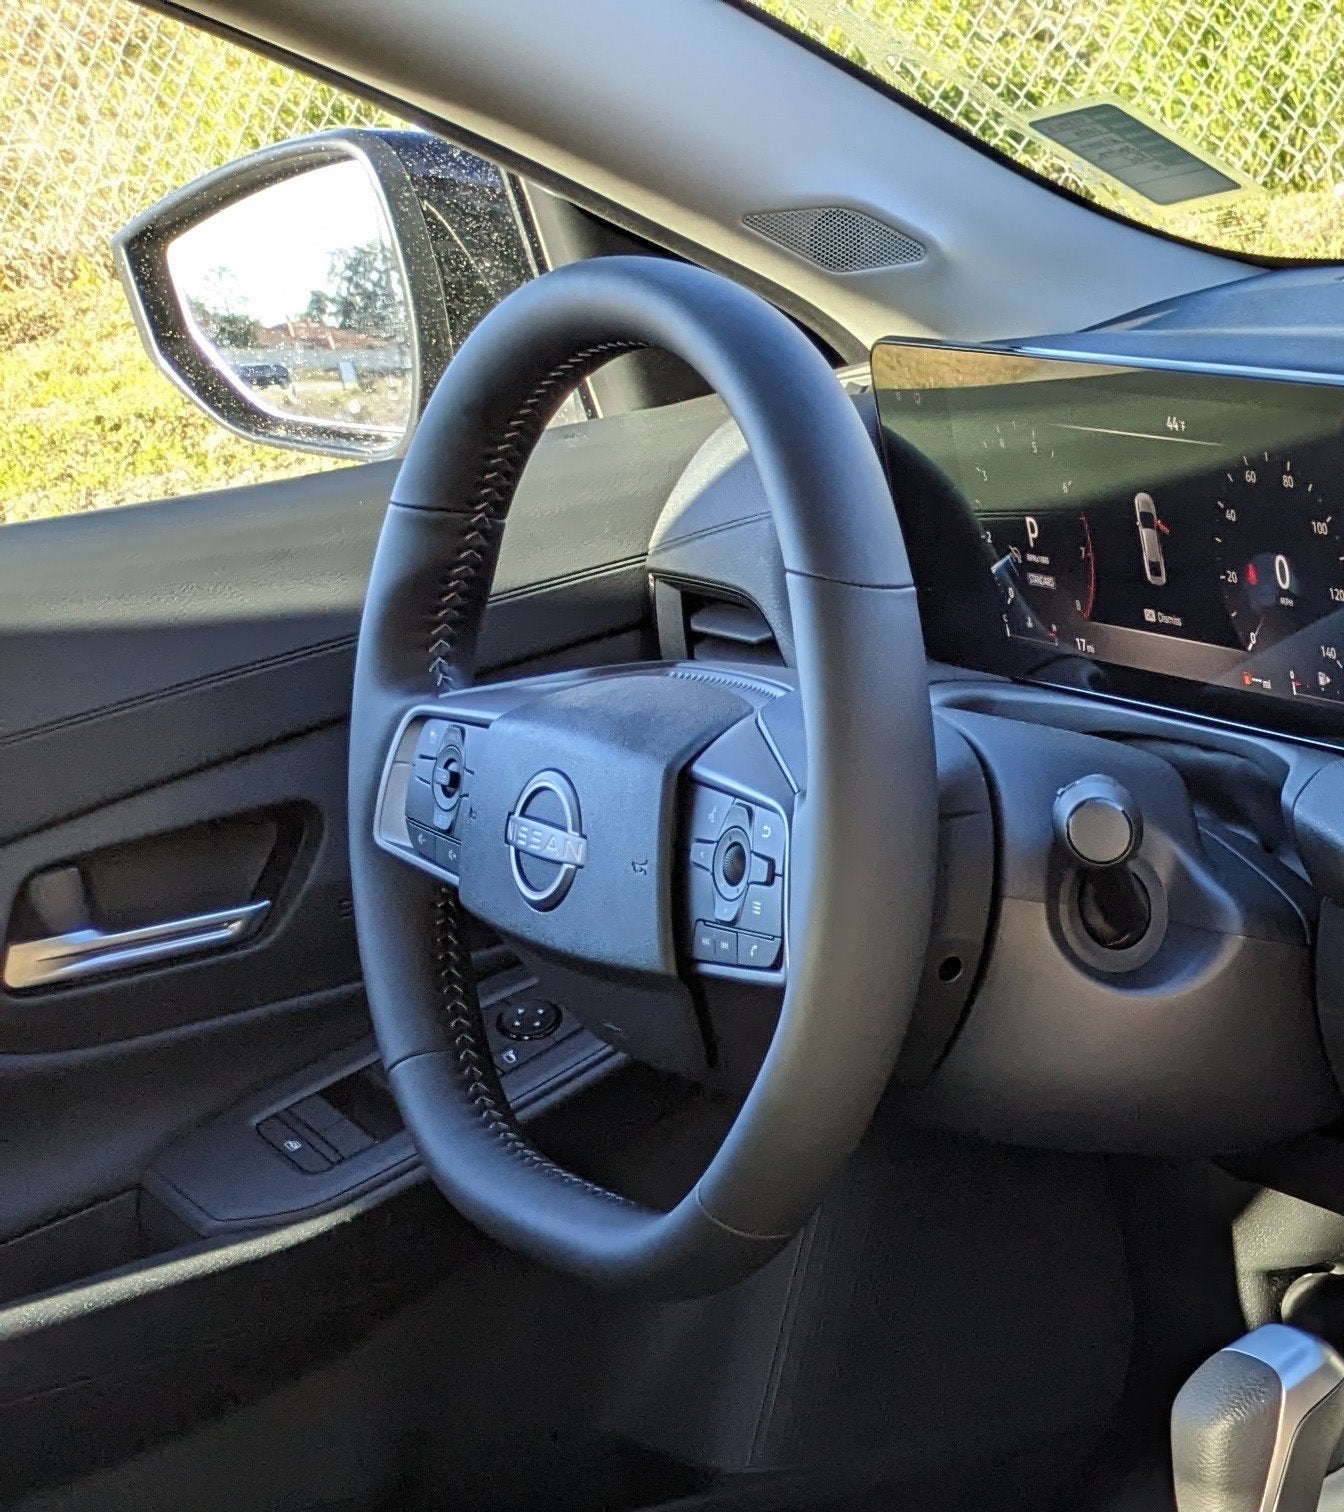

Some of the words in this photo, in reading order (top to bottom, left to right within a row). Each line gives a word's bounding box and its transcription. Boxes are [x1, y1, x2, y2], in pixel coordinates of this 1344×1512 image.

[1245, 470, 1257, 483] 60
[1282, 475, 1294, 488] 80
[1025, 516, 1038, 548] P
[1311, 521, 1328, 535] 100
[1275, 555, 1290, 590] 0
[1329, 588, 1344, 602] 120
[1321, 645, 1337, 660] 140
